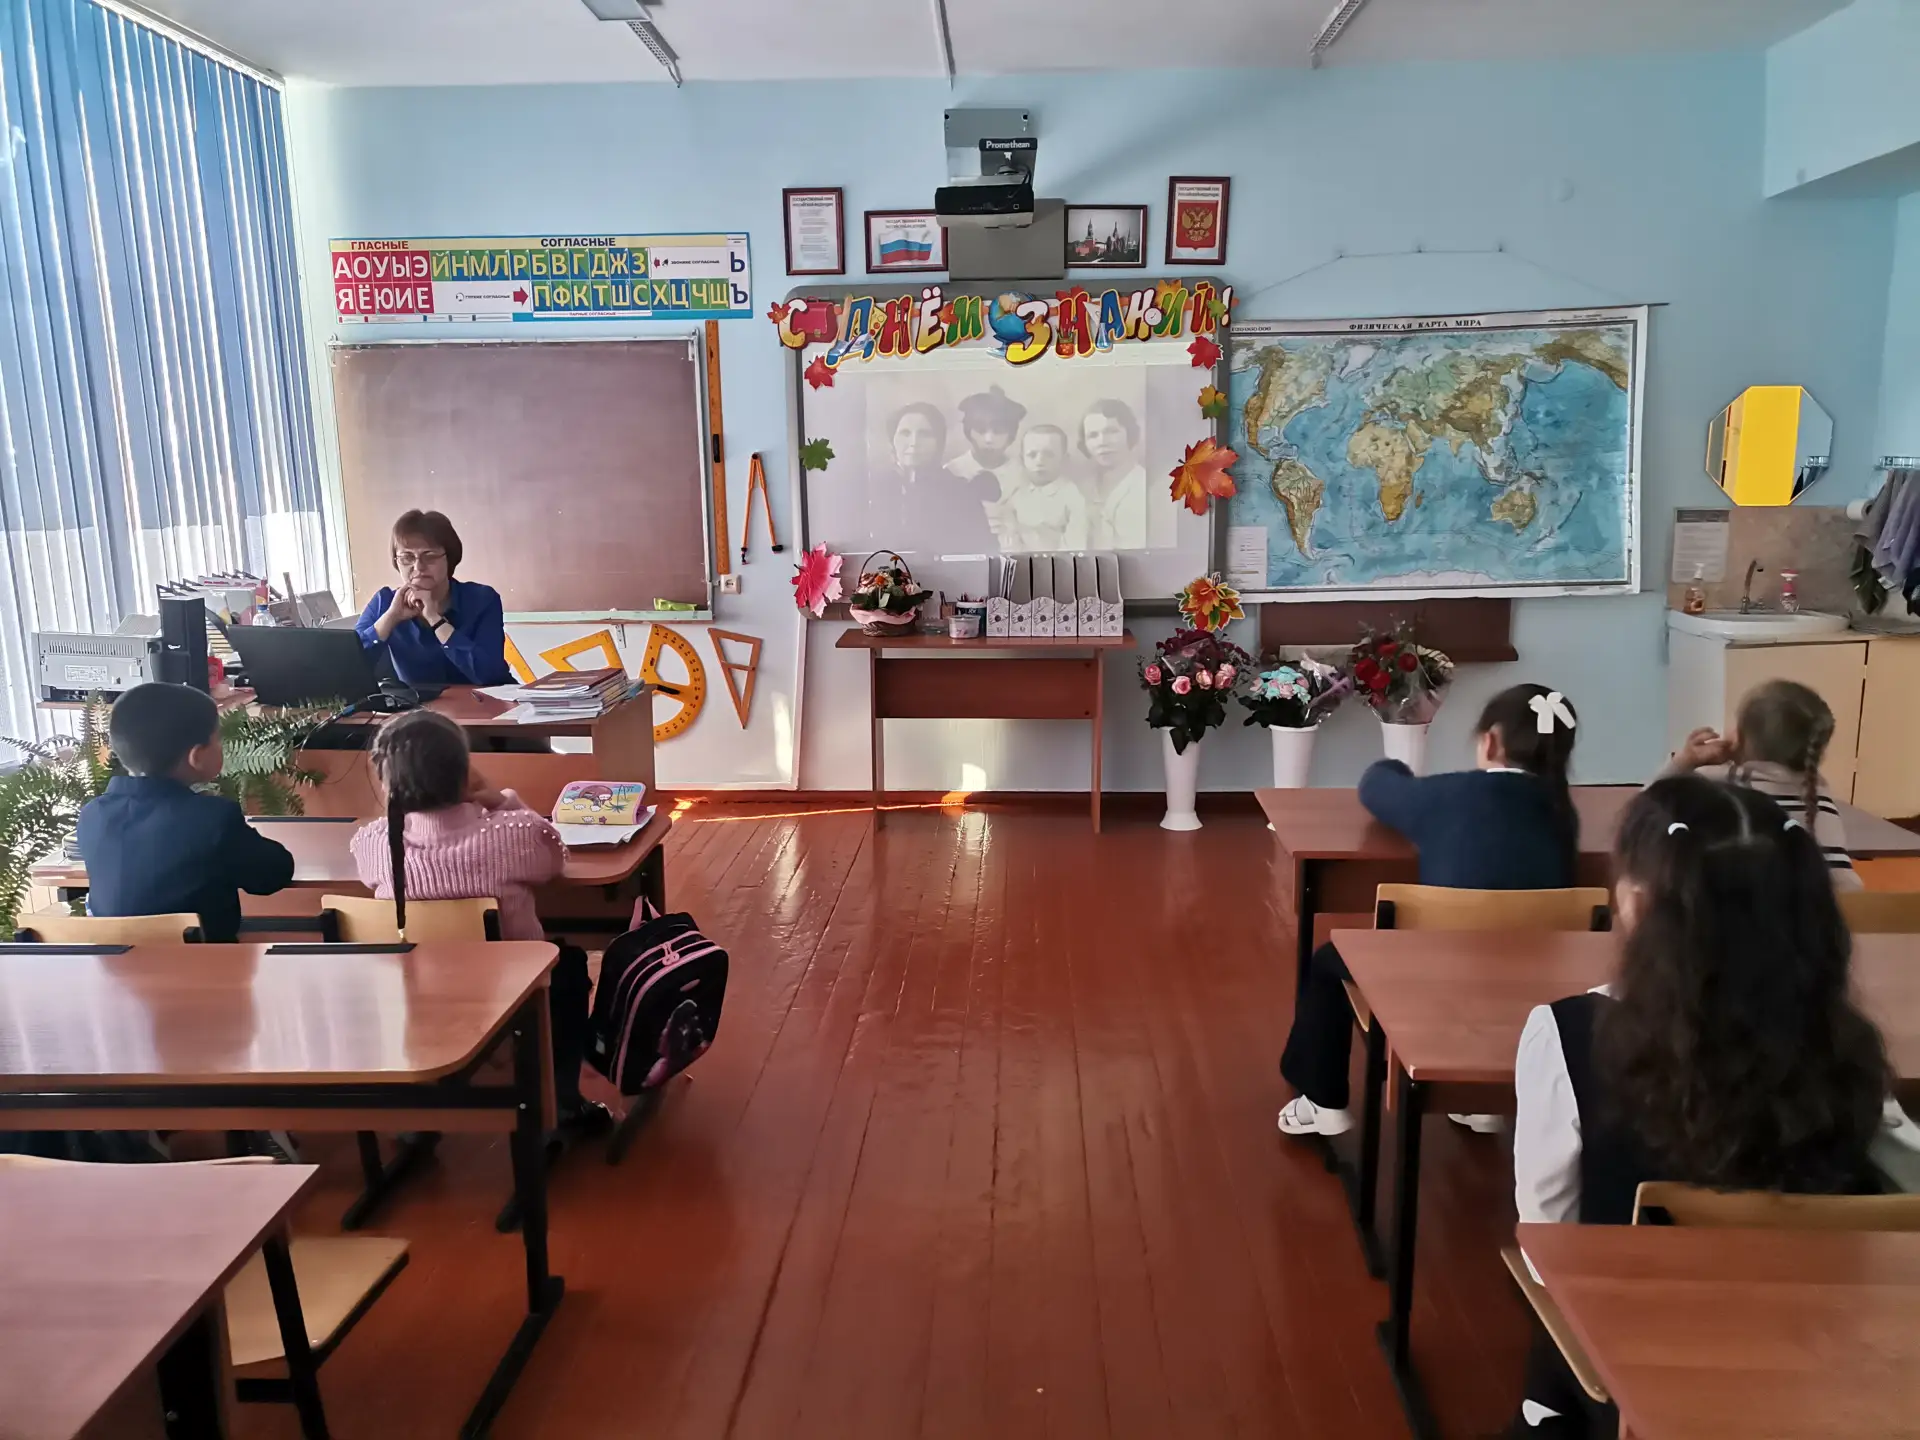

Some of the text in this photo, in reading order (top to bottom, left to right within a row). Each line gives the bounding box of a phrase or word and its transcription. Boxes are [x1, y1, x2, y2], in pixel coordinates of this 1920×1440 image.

[986, 140, 1030, 149] Promethean
[351, 240, 409, 250] ГЛАСНЫЕ
[541, 237, 616, 247] СОГЛАСНЫЕ
[730, 251, 746, 273] Ь
[778, 281, 1233, 369] С ДНЁМ ЗНАНИЙ!
[1349, 322, 1412, 330] ФИЗИЧЕСКАЯ
[1418, 320, 1448, 328] КАРТА
